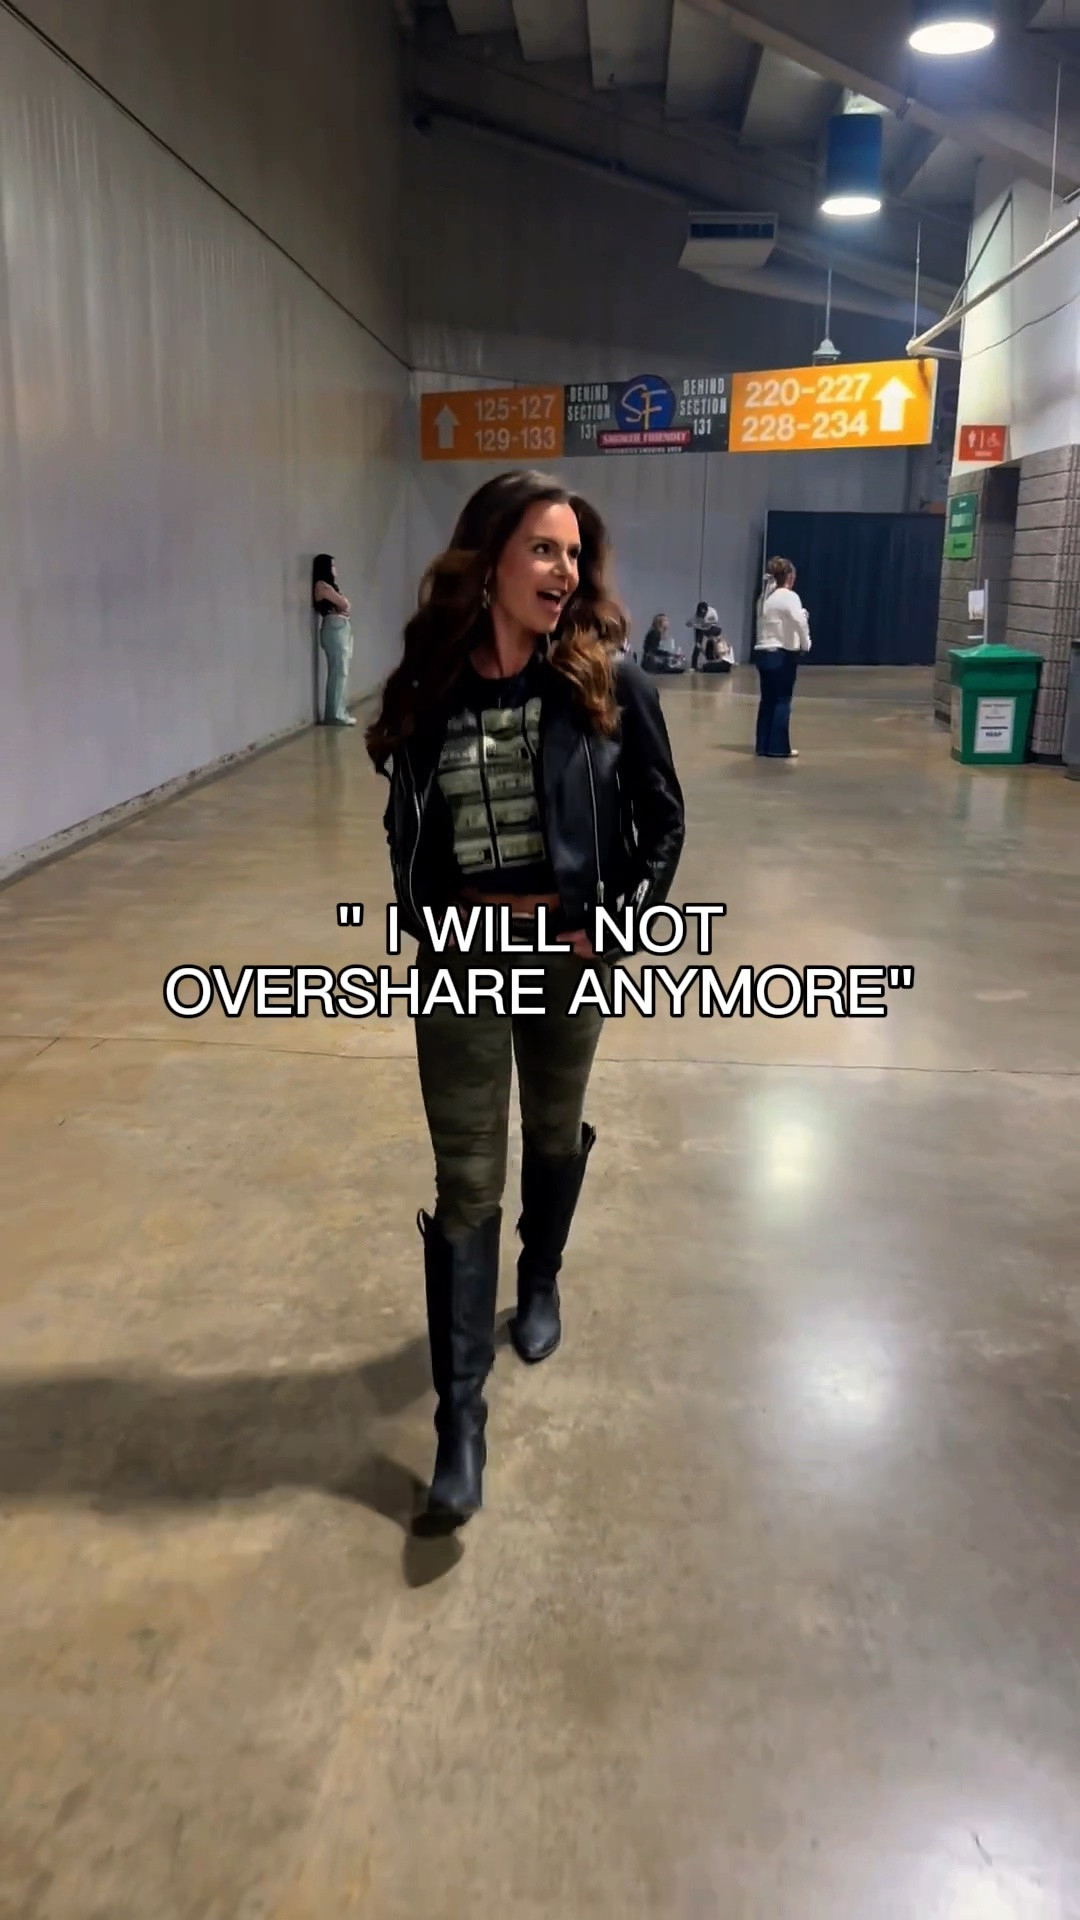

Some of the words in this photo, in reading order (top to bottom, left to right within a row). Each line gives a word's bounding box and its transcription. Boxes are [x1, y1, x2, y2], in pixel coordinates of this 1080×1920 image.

[569, 385, 609, 402] BEHIND
[683, 378, 725, 396] BEHIND
[745, 373, 871, 408] 220-227
[475, 394, 556, 421] 125-127
[567, 404, 611, 421] SECTION
[679, 398, 727, 416] SECTION
[580, 423, 597, 440] 131
[693, 418, 712, 435] 131
[741, 409, 869, 443] 228-234
[475, 425, 556, 451] 129-133
